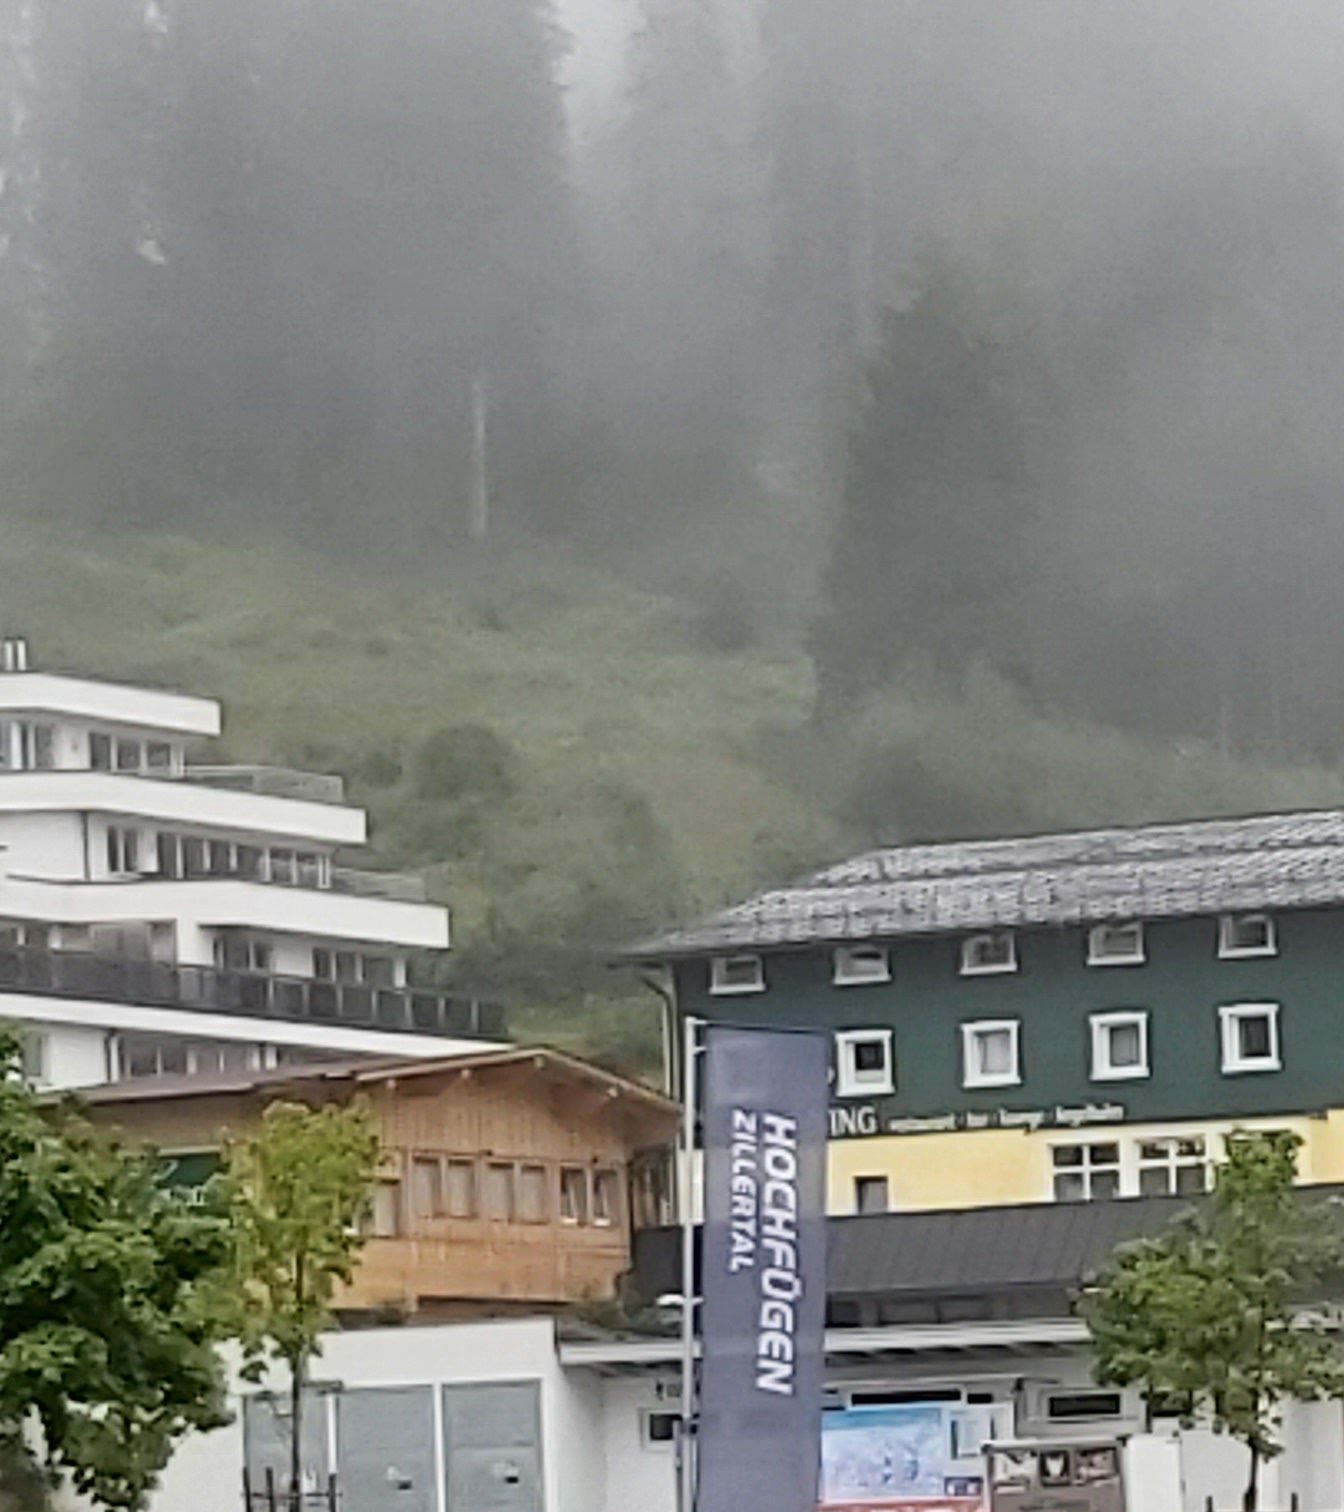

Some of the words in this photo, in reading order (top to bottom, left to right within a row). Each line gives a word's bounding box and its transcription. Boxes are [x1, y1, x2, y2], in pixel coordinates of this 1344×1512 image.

[729, 1109, 757, 1273] ZILLERTAL
[827, 1105, 877, 1138] ING
[756, 1111, 802, 1396] HOCHFÜGEN
